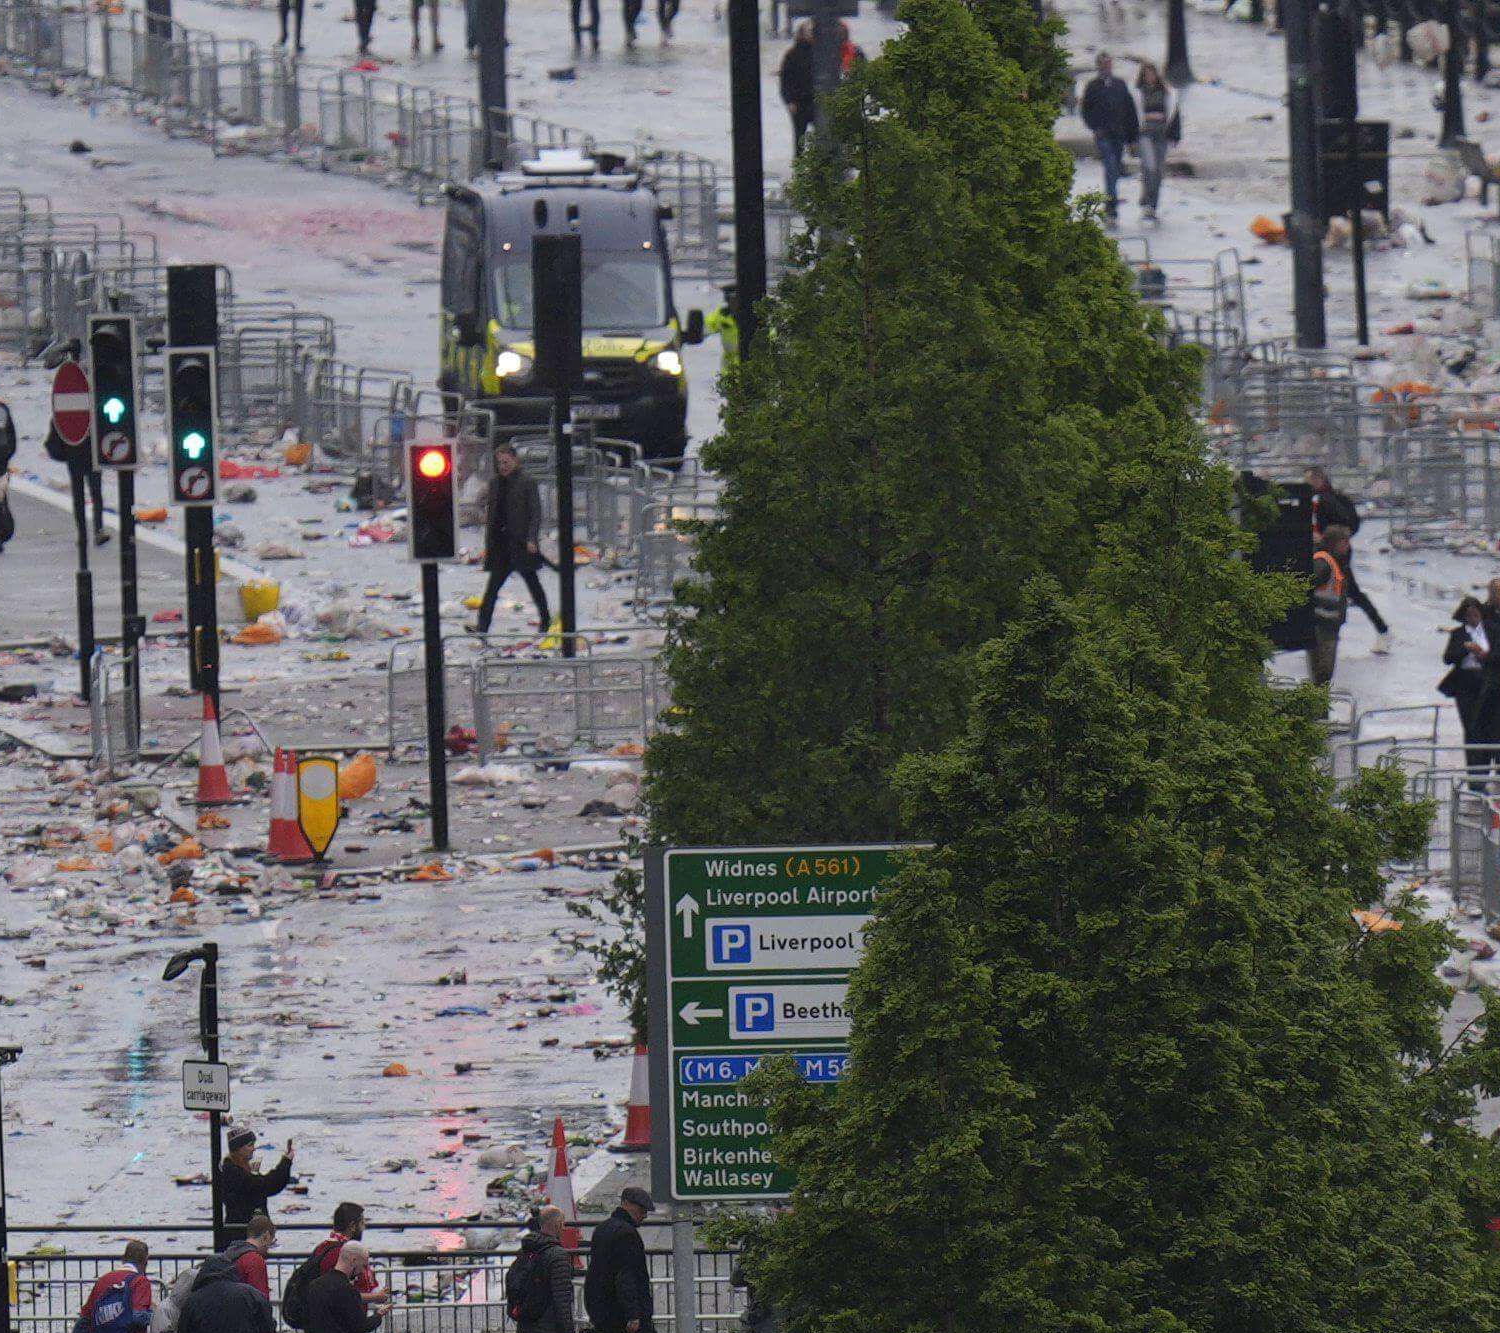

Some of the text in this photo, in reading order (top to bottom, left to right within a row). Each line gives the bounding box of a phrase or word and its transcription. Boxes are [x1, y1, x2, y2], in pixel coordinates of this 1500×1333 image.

[706, 860, 778, 878] Widnes
[706, 885, 878, 909] Liverpool Airport
[760, 931, 854, 954] Liverpool
[783, 1002, 853, 1020] Beetha
[197, 1070, 214, 1084] Dual
[187, 1089, 228, 1105] carriageway
[682, 1119, 777, 1138] Southpo
[684, 1148, 779, 1165] Birkenhe
[684, 1169, 773, 1190] Wallasey
